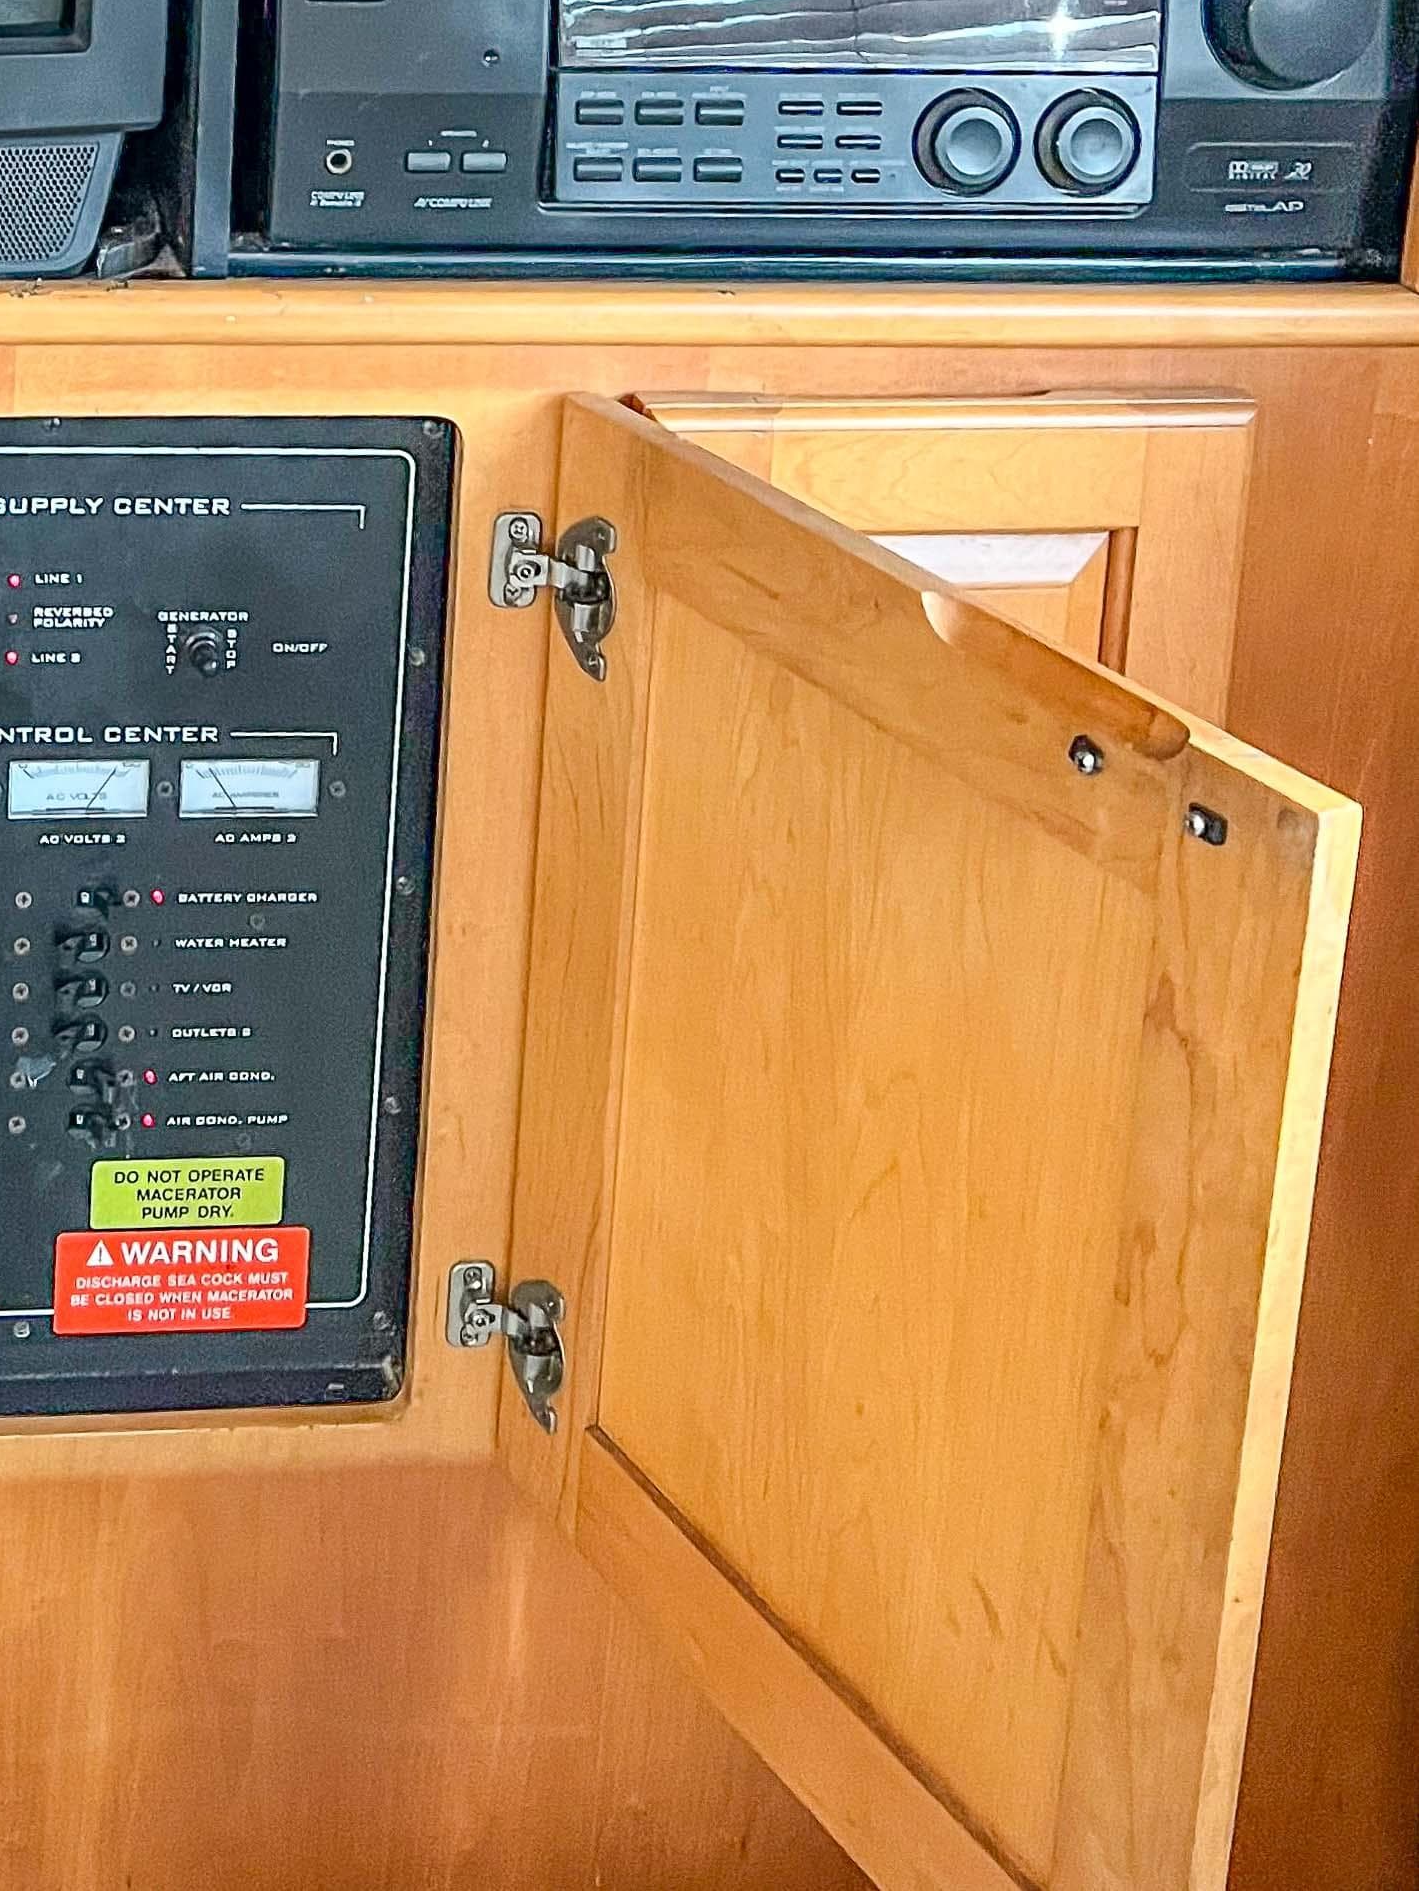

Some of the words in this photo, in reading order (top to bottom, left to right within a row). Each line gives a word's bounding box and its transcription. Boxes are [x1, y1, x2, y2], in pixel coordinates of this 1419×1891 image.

[113, 497, 230, 516] CENTER
[35, 573, 70, 584] LINE
[76, 573, 83, 584] 1
[33, 606, 114, 618] REVERSED
[157, 611, 249, 622] GENERATOR
[33, 617, 106, 628] POLARITY
[165, 623, 179, 674] START
[225, 628, 239, 669] STOP
[272, 642, 328, 653] ON/OFF
[31, 652, 67, 663] LINE
[104, 726, 218, 743] CENTER
[39, 834, 63, 845] AC
[64, 834, 113, 844] VOLTS
[214, 833, 235, 843] AC
[239, 833, 282, 843] AMPS
[178, 892, 242, 903] BATTERY
[246, 892, 318, 903] CHARGER
[175, 938, 224, 948] WATER
[229, 937, 287, 948] HEATER
[172, 983, 191, 994] TV
[193, 983, 200, 993] /
[202, 983, 232, 993] VCR
[172, 1027, 237, 1038] OUTLETS
[168, 1072, 196, 1082] AFT
[198, 1072, 224, 1082] AIR
[166, 1116, 191, 1126] AIR
[247, 1114, 288, 1125] PUMP
[114, 1171, 139, 1184] DO
[147, 1170, 181, 1183] NOT
[188, 1168, 265, 1182] OPERATE
[136, 1187, 241, 1201] MACERATOR
[142, 1206, 189, 1220] PUMP
[120, 1238, 279, 1265] WARNING
[76, 1274, 161, 1289] DISCHARGE
[167, 1274, 195, 1287] SEA
[201, 1273, 242, 1286] COCK
[248, 1271, 288, 1284] MUST
[70, 1294, 89, 1307] BE
[95, 1292, 154, 1306] CLOSED
[159, 1291, 201, 1303] WHEN
[208, 1289, 293, 1302] MACERATOR
[128, 1310, 143, 1322] IS
[148, 1309, 176, 1321] NOT
[182, 1308, 199, 1321] IN
[202, 1307, 231, 1320] USE
